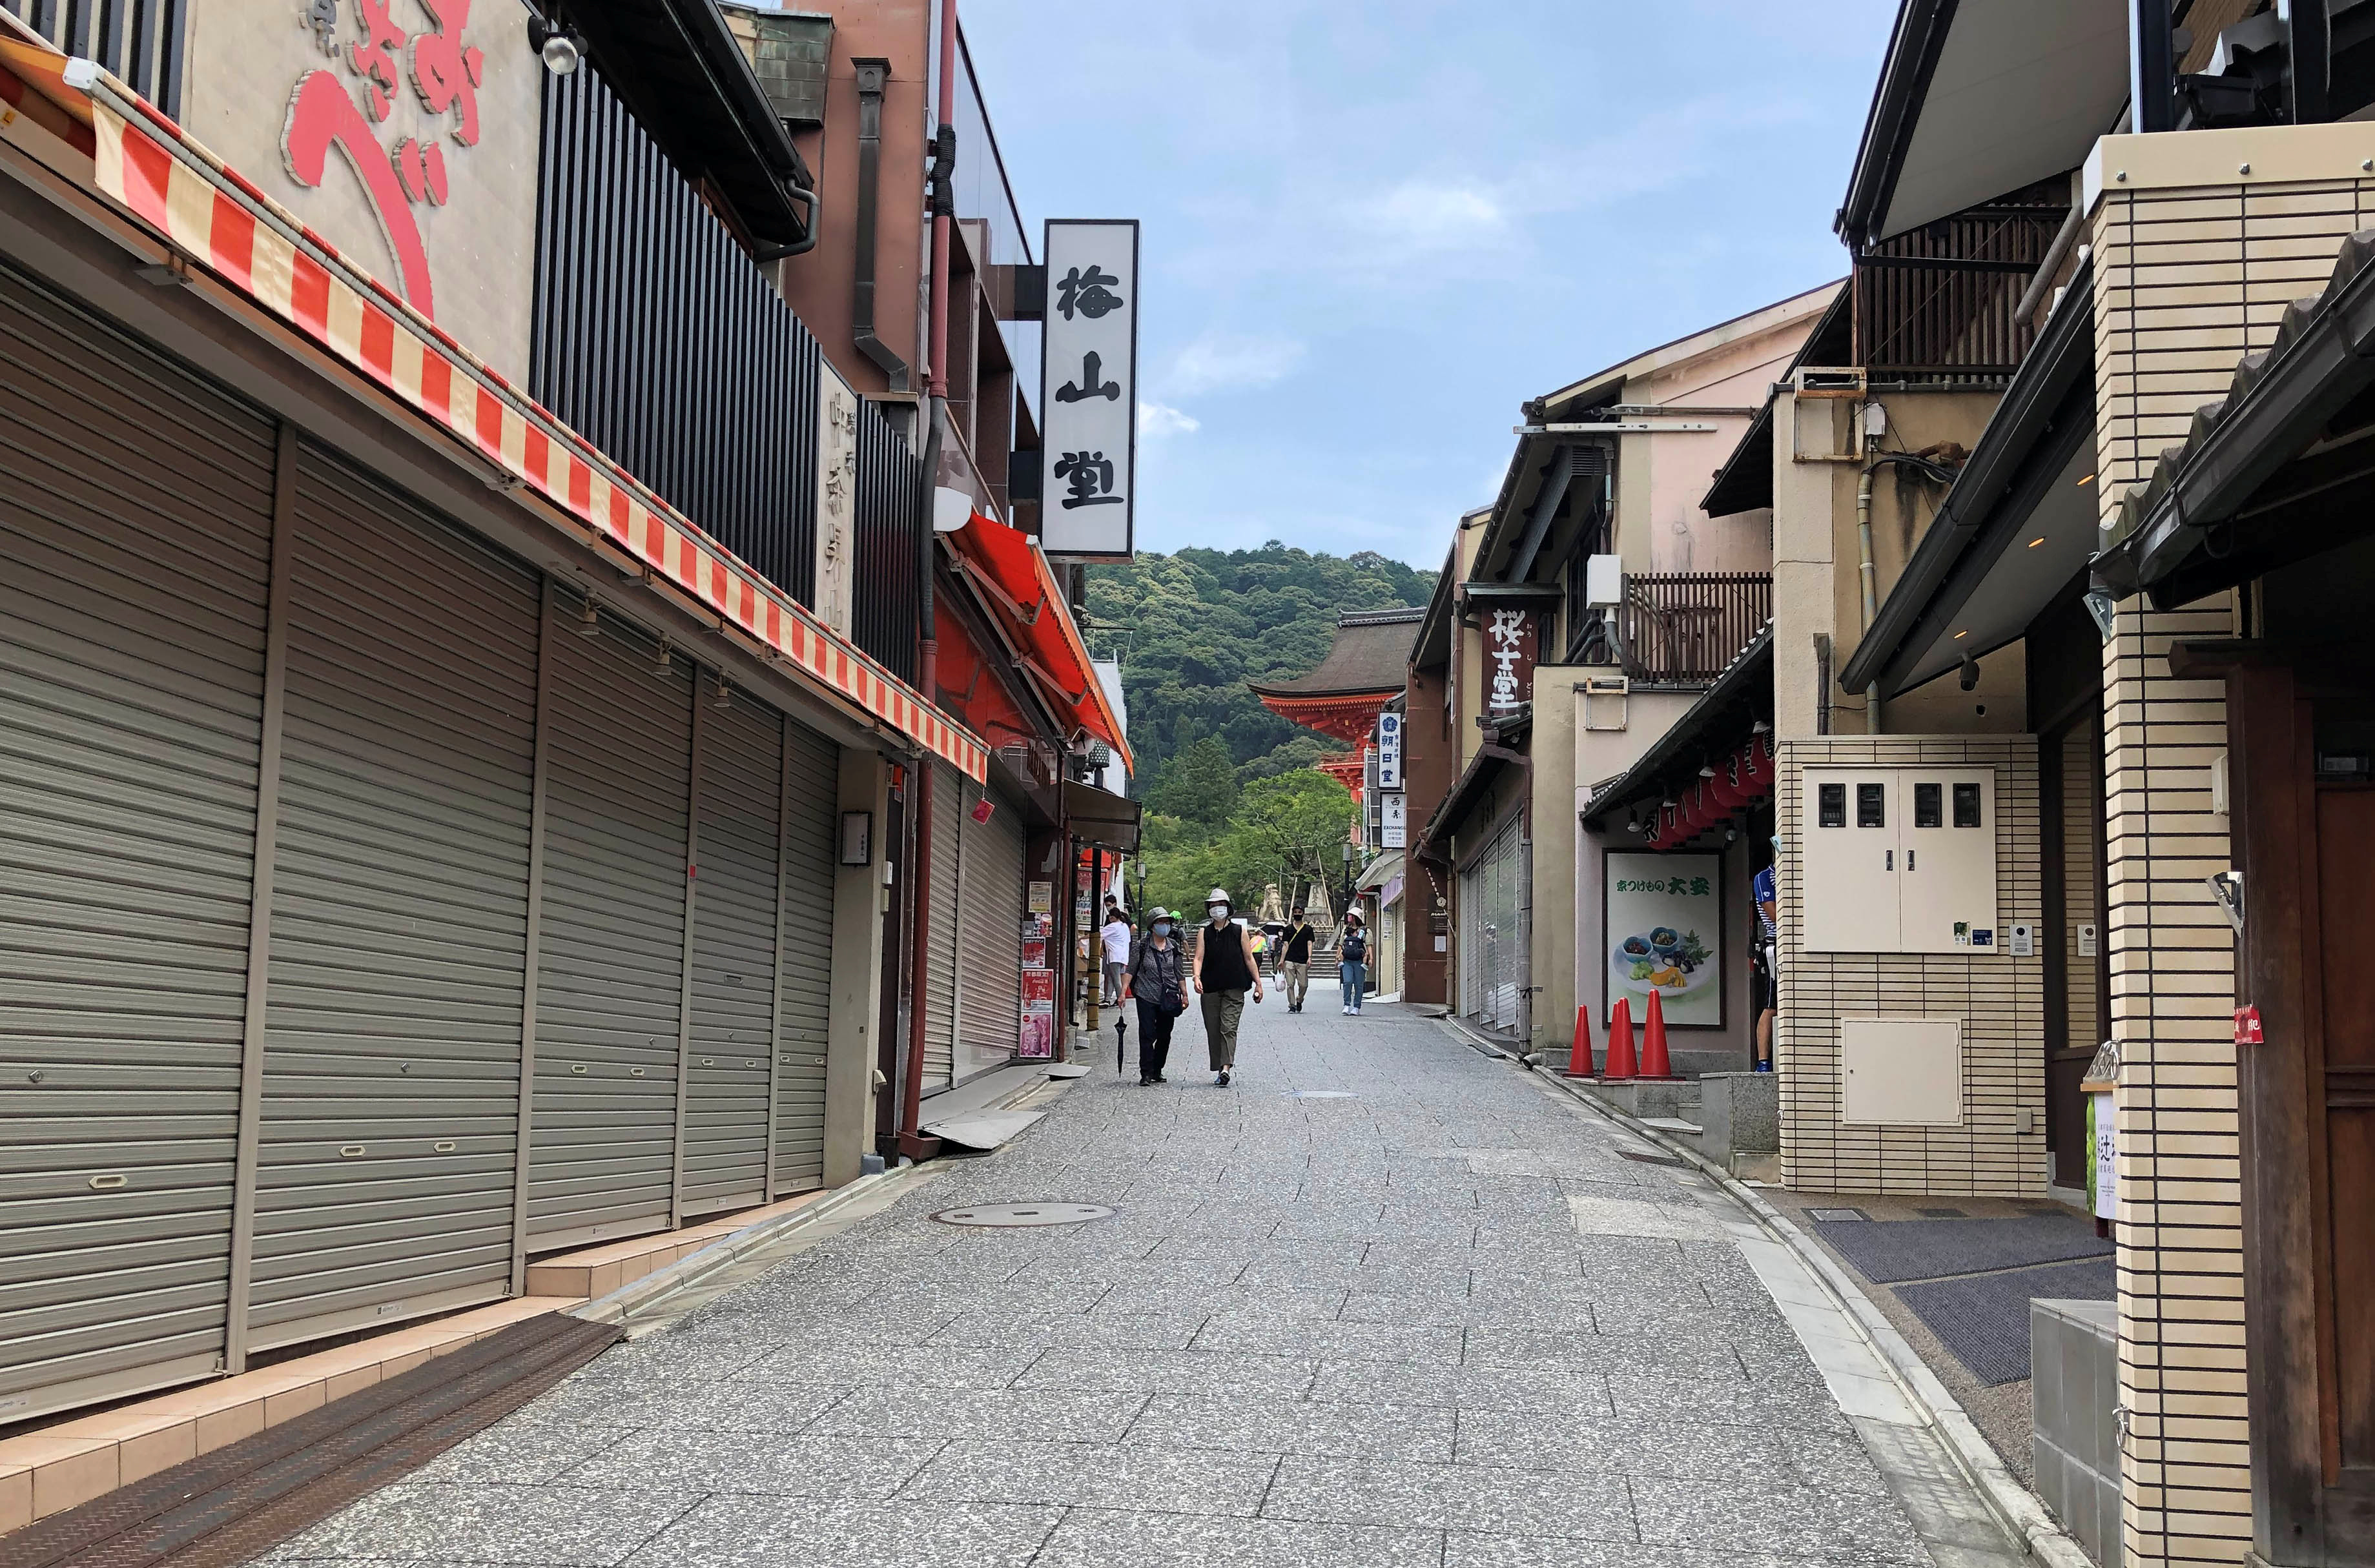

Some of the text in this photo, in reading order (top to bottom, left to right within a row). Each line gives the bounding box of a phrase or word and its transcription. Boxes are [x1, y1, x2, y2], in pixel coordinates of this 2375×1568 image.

[1054, 264, 1124, 510] 梅山堂
[1487, 608, 1526, 709] 桜士堂
[1381, 735, 1394, 782] 朝日堂
[1616, 876, 1711, 896] 京つけもの 大安
